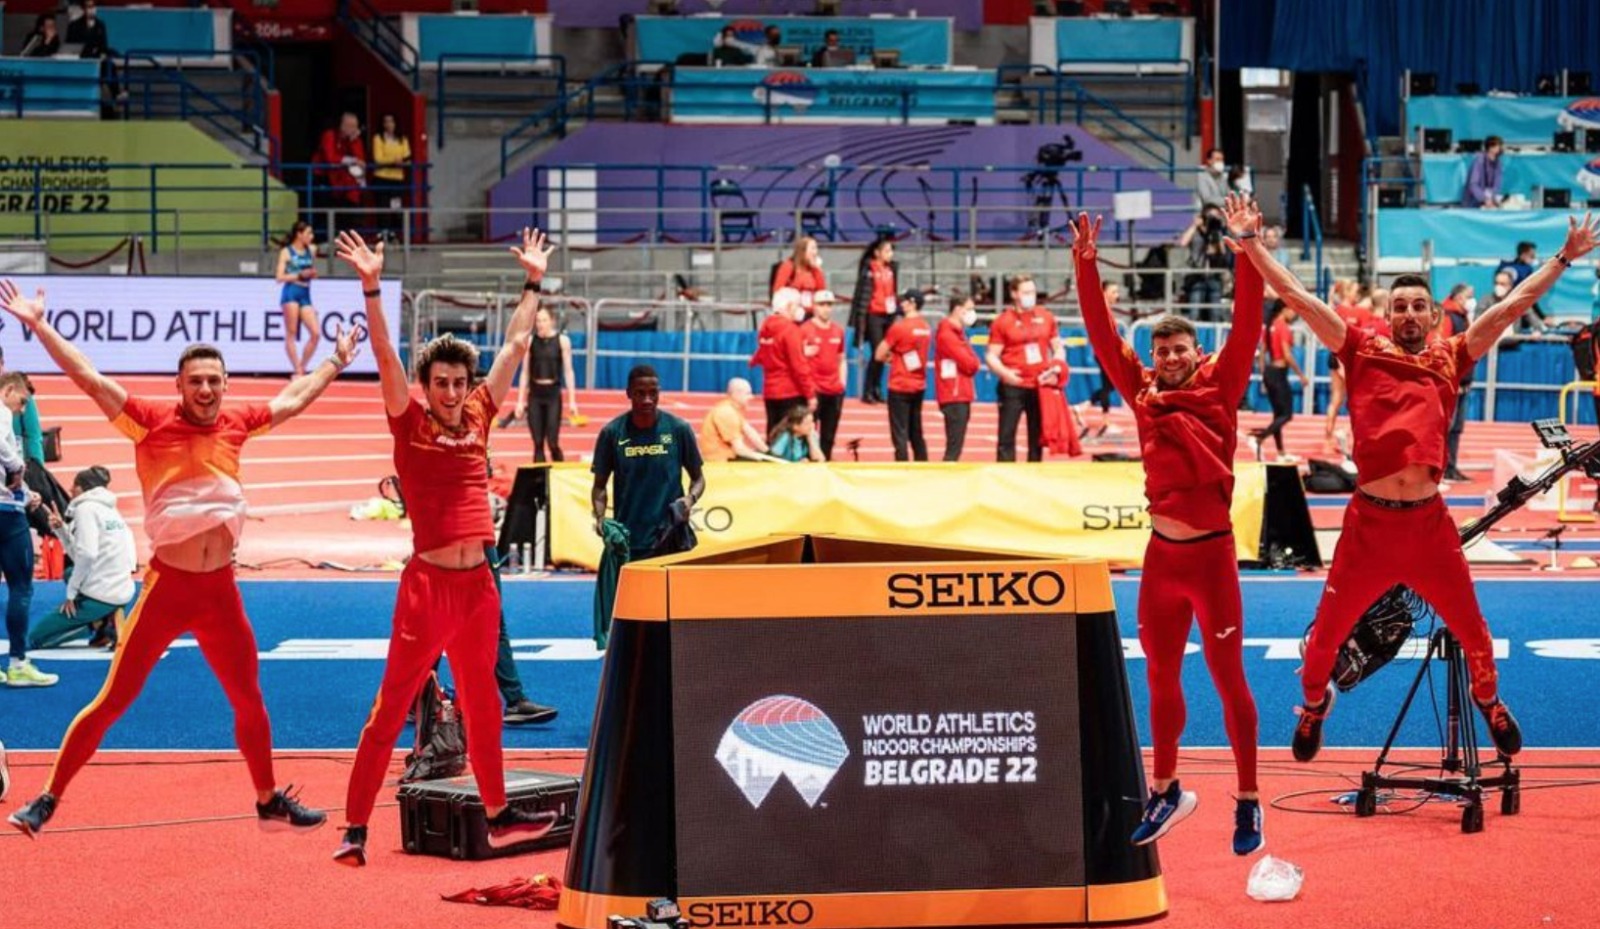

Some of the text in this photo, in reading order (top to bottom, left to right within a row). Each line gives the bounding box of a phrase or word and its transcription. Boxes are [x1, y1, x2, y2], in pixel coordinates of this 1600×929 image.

[18, 156, 109, 172] ATHLETICS
[80, 194, 111, 212] 22
[164, 310, 369, 342] ATHLECS
[625, 444, 668, 457] BRASIL
[887, 570, 1066, 609] SEIKO
[862, 711, 1037, 736] WORLD ATHLETICS
[862, 736, 1038, 756] INDOOR CHAMPIONSHIPS
[864, 756, 1038, 787] BELGRADE 22
[687, 900, 814, 928] SEIKO
